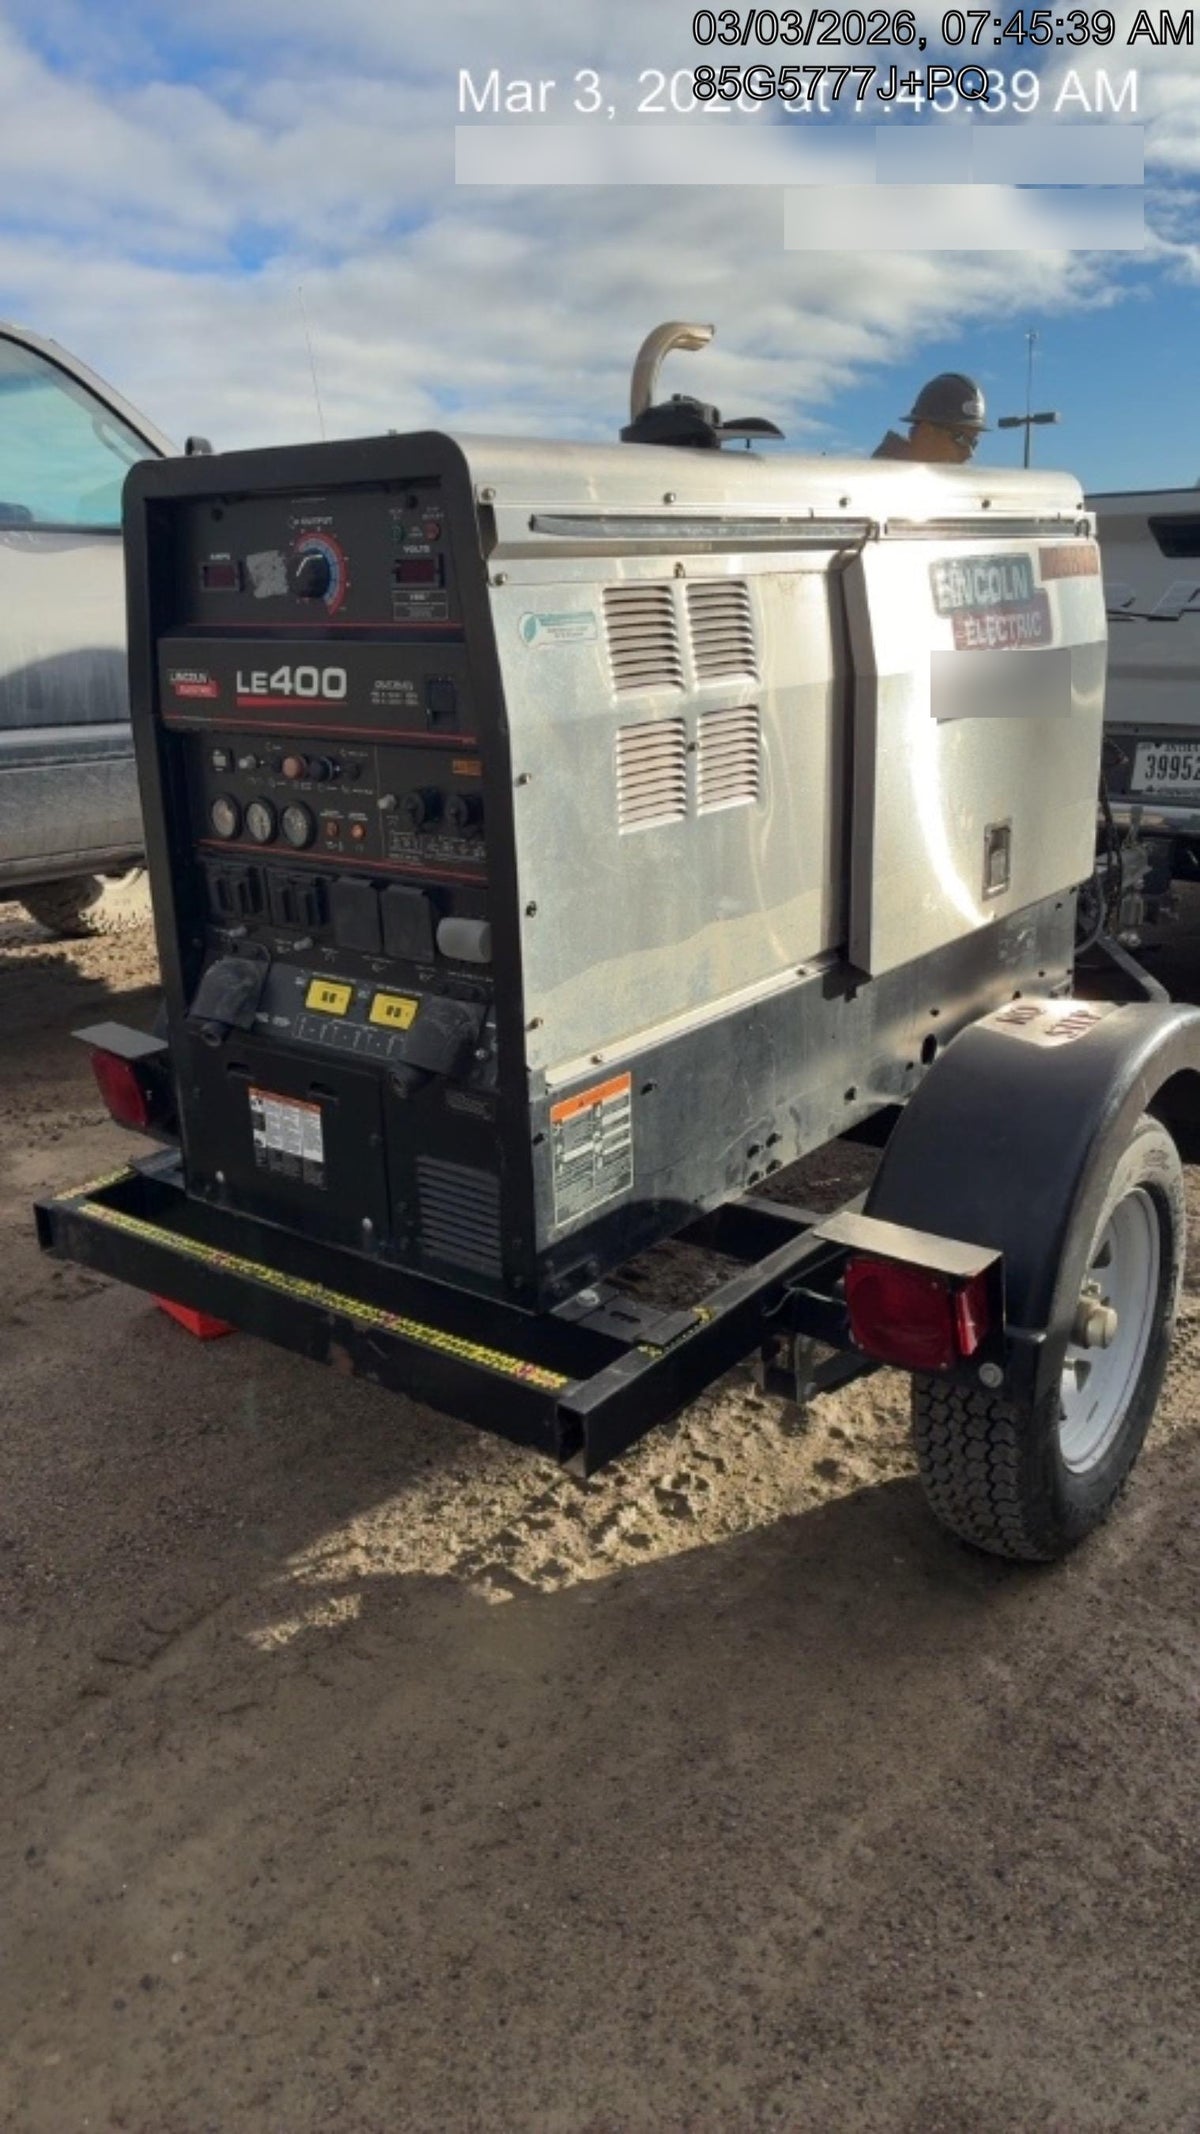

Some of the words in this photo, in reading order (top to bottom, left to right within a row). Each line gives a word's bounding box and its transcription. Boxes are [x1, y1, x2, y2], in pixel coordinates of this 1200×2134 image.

[937, 562, 1029, 608] LINCOLN
[965, 611, 1042, 646] ELECTRIC
[236, 665, 348, 699] LE400
